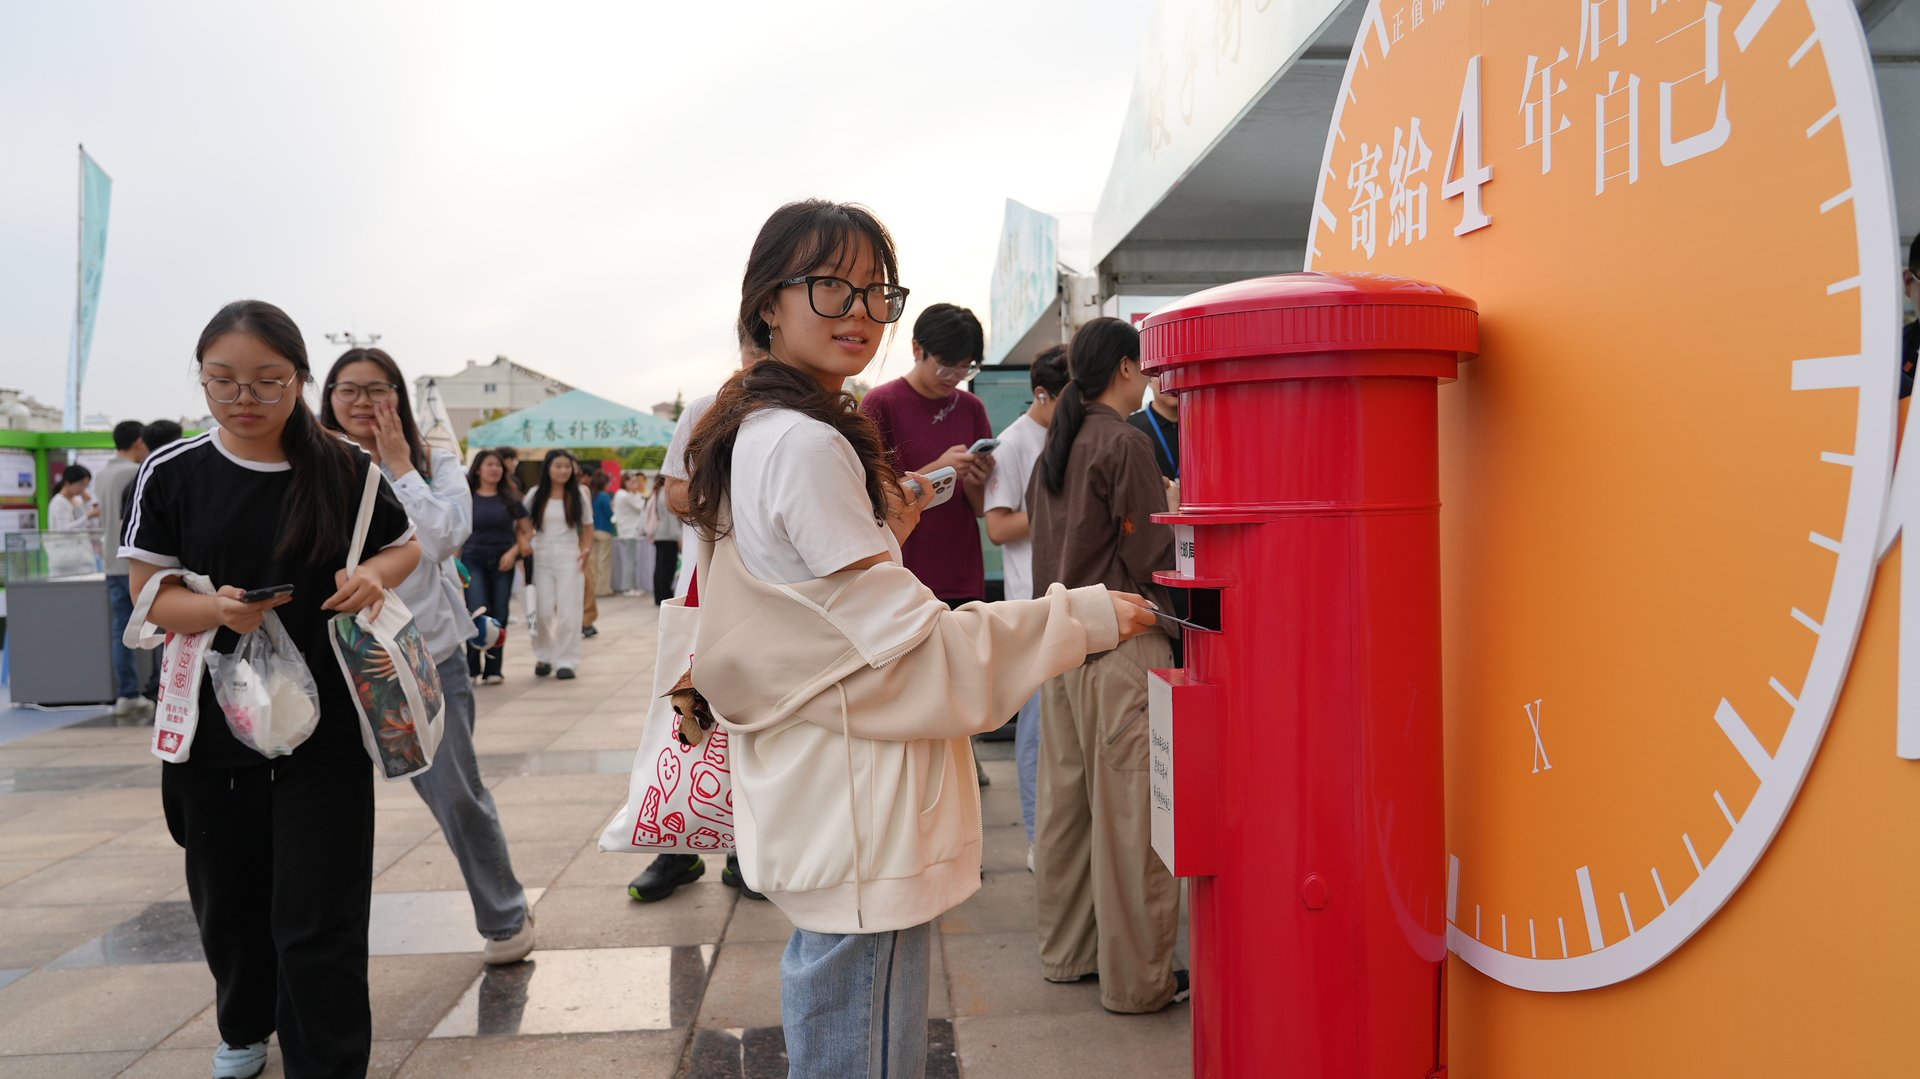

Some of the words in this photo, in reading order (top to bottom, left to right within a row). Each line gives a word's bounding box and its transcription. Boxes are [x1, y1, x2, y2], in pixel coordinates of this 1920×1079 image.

[515, 417, 641, 443] 青春补给站
